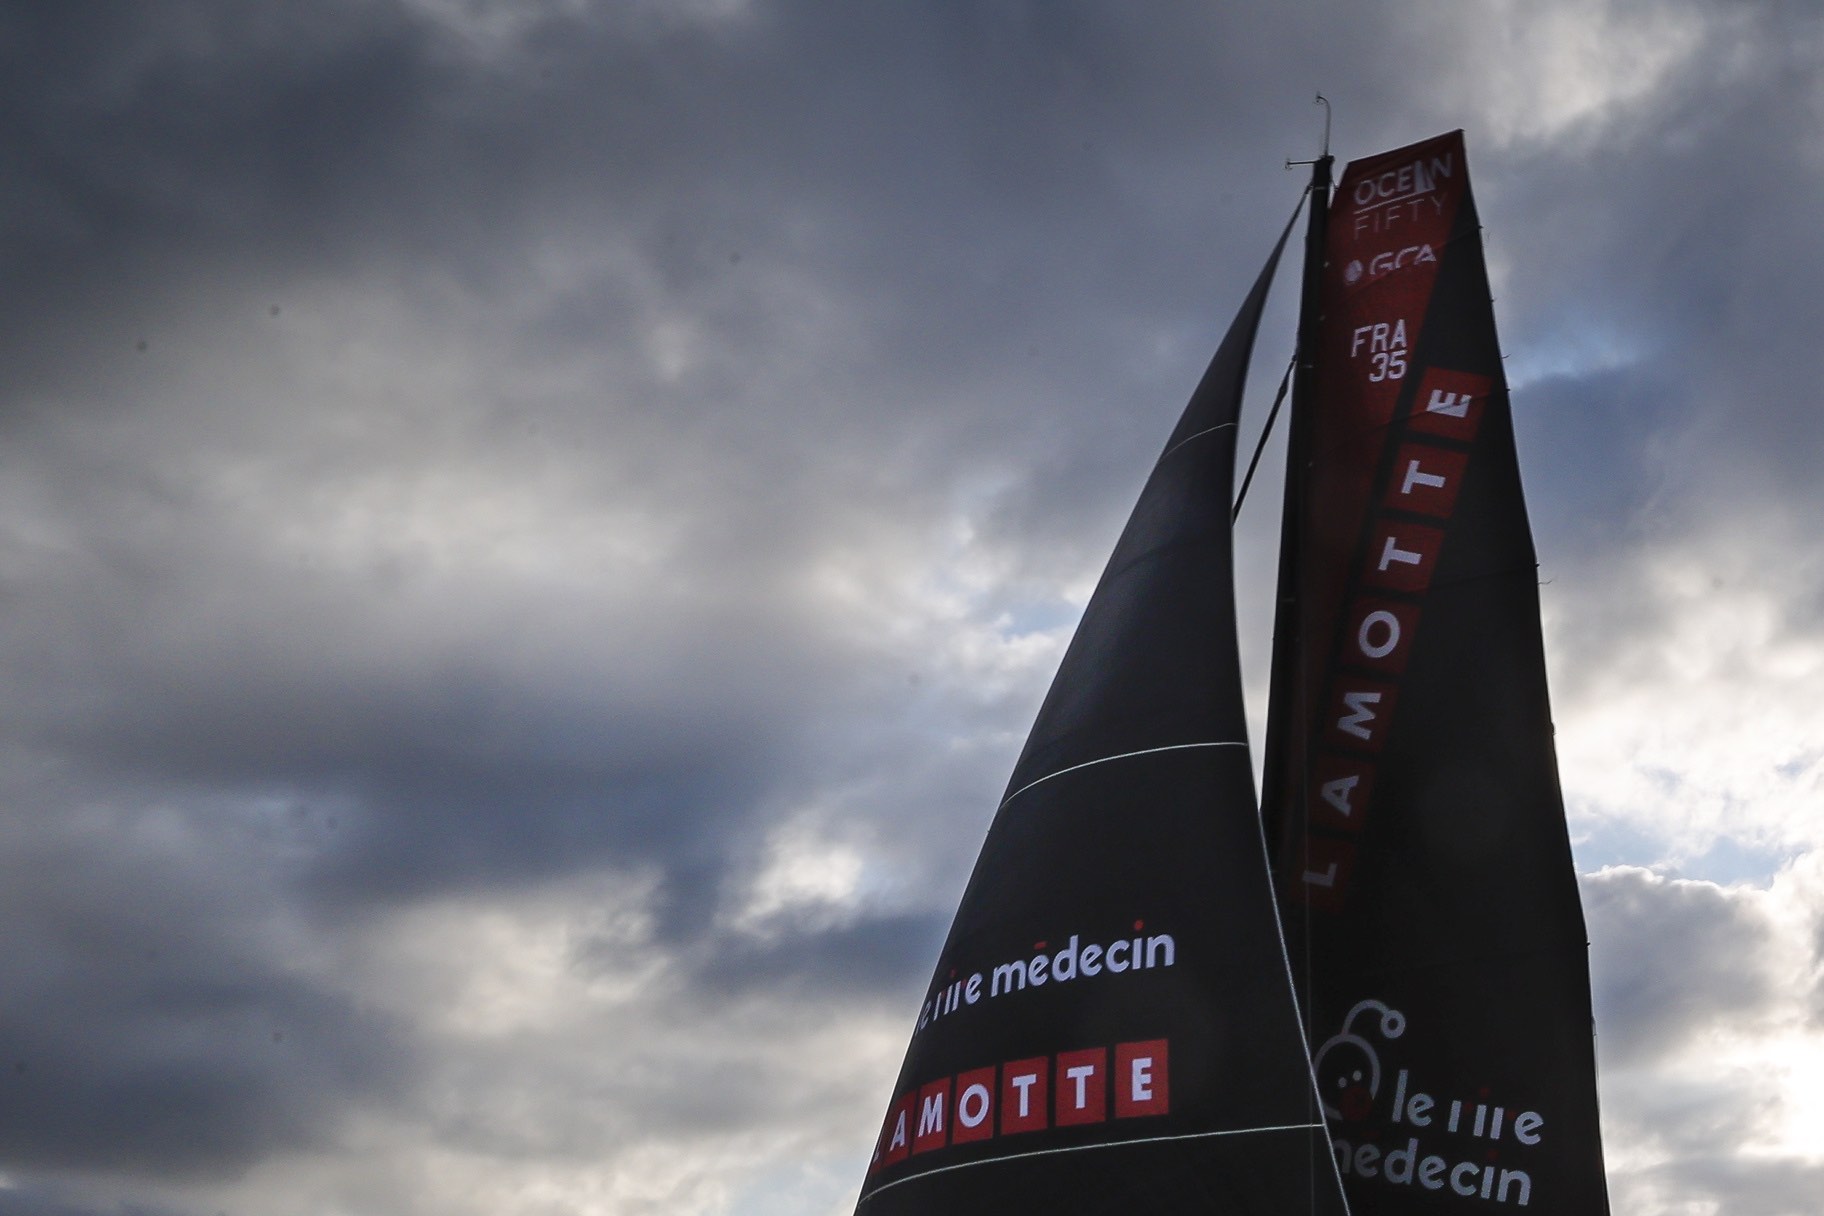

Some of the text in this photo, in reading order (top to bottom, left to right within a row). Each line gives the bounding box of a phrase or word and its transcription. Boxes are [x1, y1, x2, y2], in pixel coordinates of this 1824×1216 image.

[1355, 192, 1448, 241] FIFTY
[1351, 318, 1408, 358] FRA
[1369, 350, 1408, 383] 35
[1302, 388, 1473, 889] LAMOTTE
[1391, 1069, 1436, 1127] le
